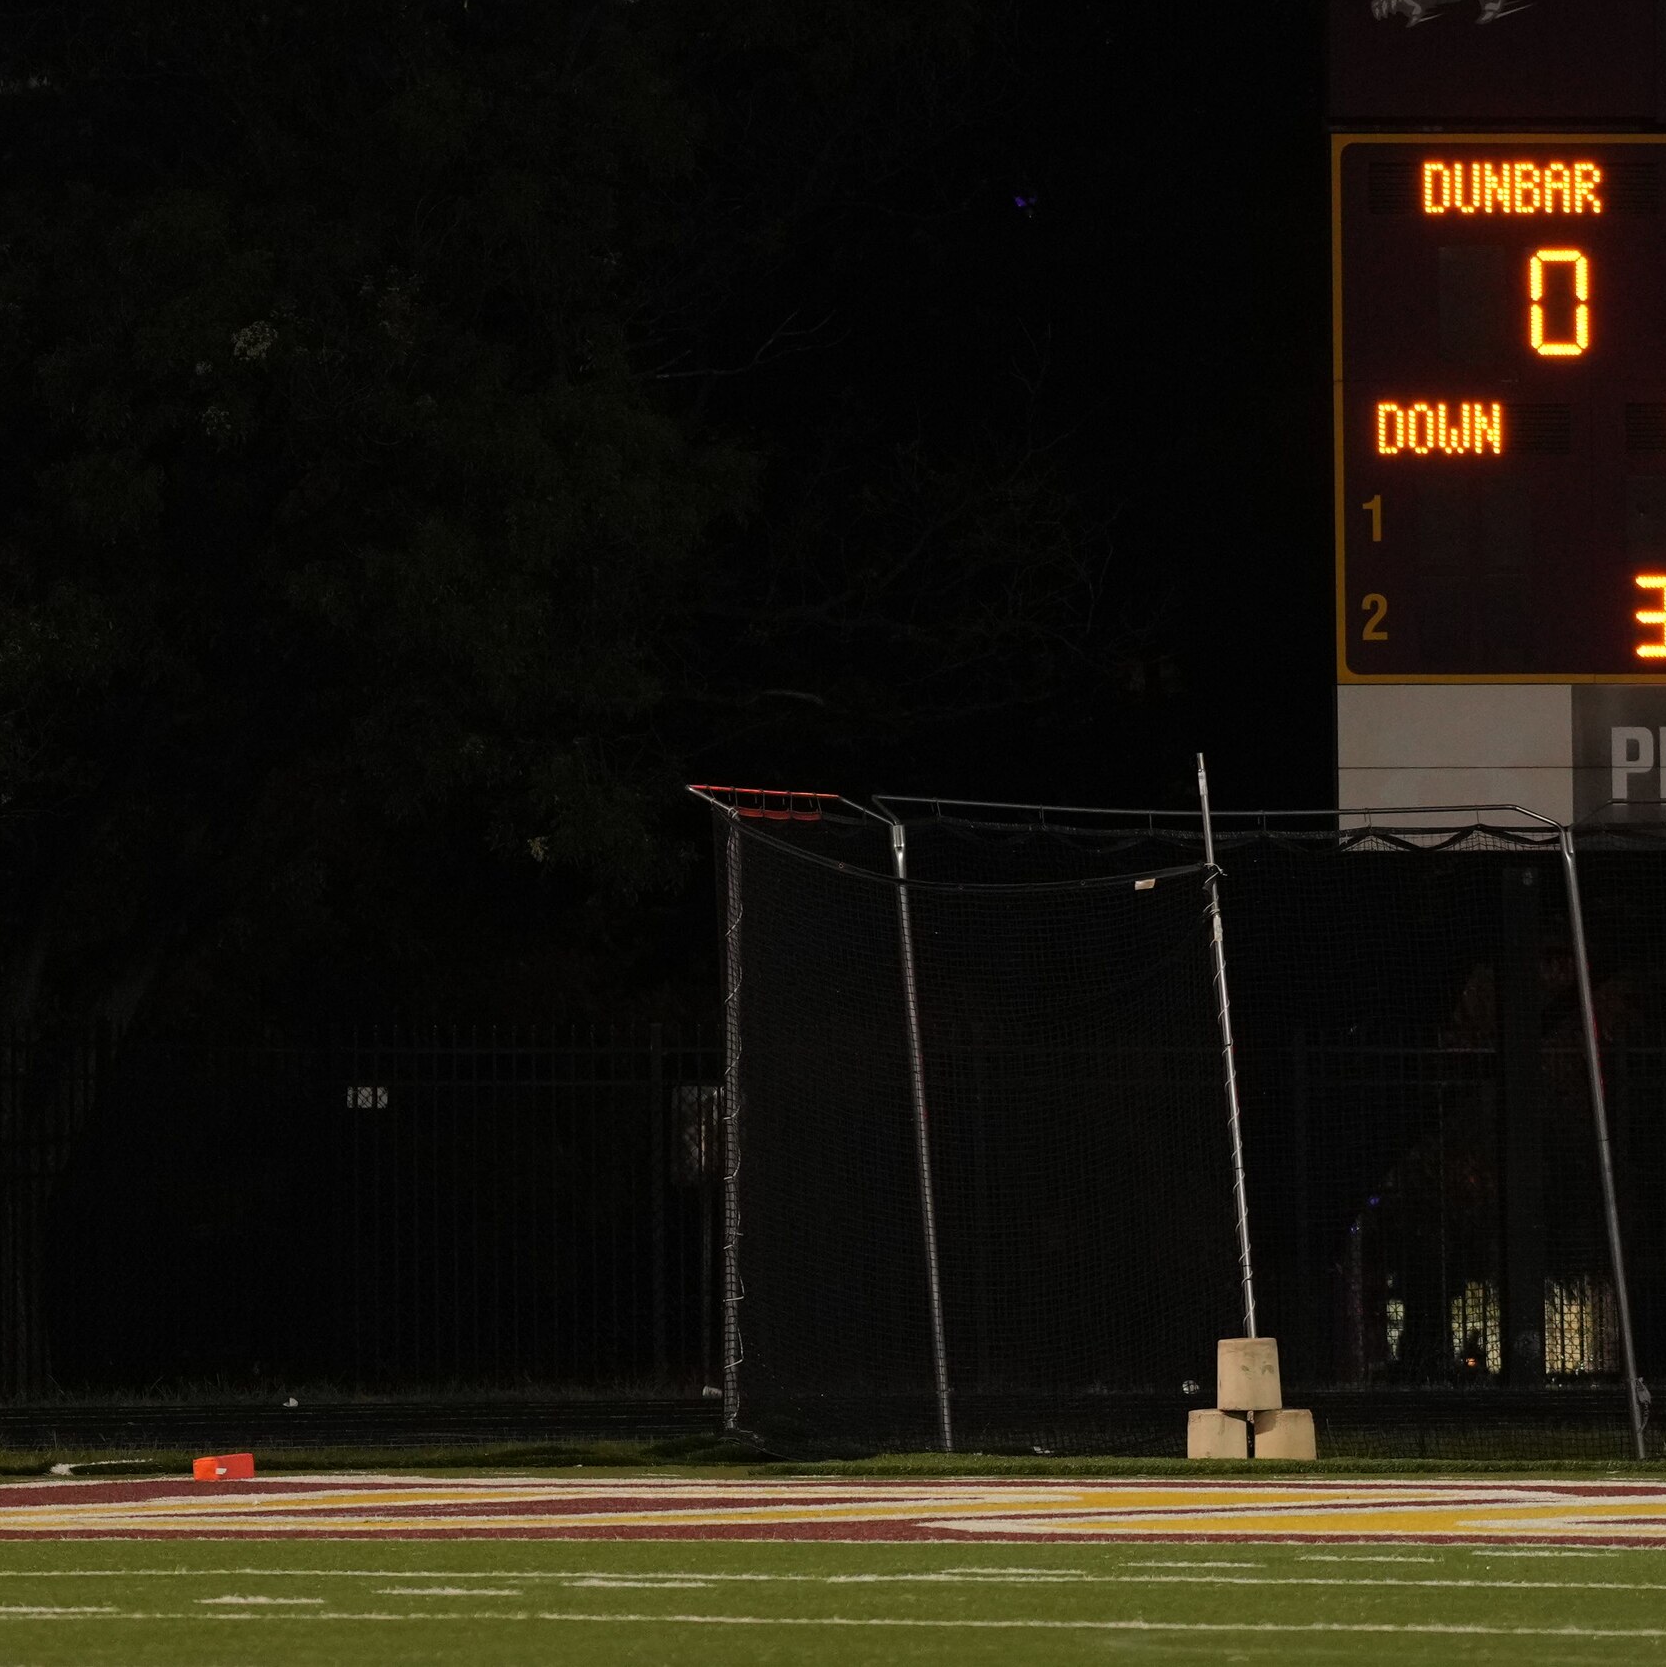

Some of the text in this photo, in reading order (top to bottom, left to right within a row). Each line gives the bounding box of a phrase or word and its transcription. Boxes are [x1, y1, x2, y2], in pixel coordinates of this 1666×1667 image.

[1423, 161, 1603, 215] DUNBAR
[1529, 248, 1590, 357] 0
[1376, 402, 1504, 456] DOWN
[1362, 494, 1383, 542] 1
[1361, 593, 1389, 641] 2
